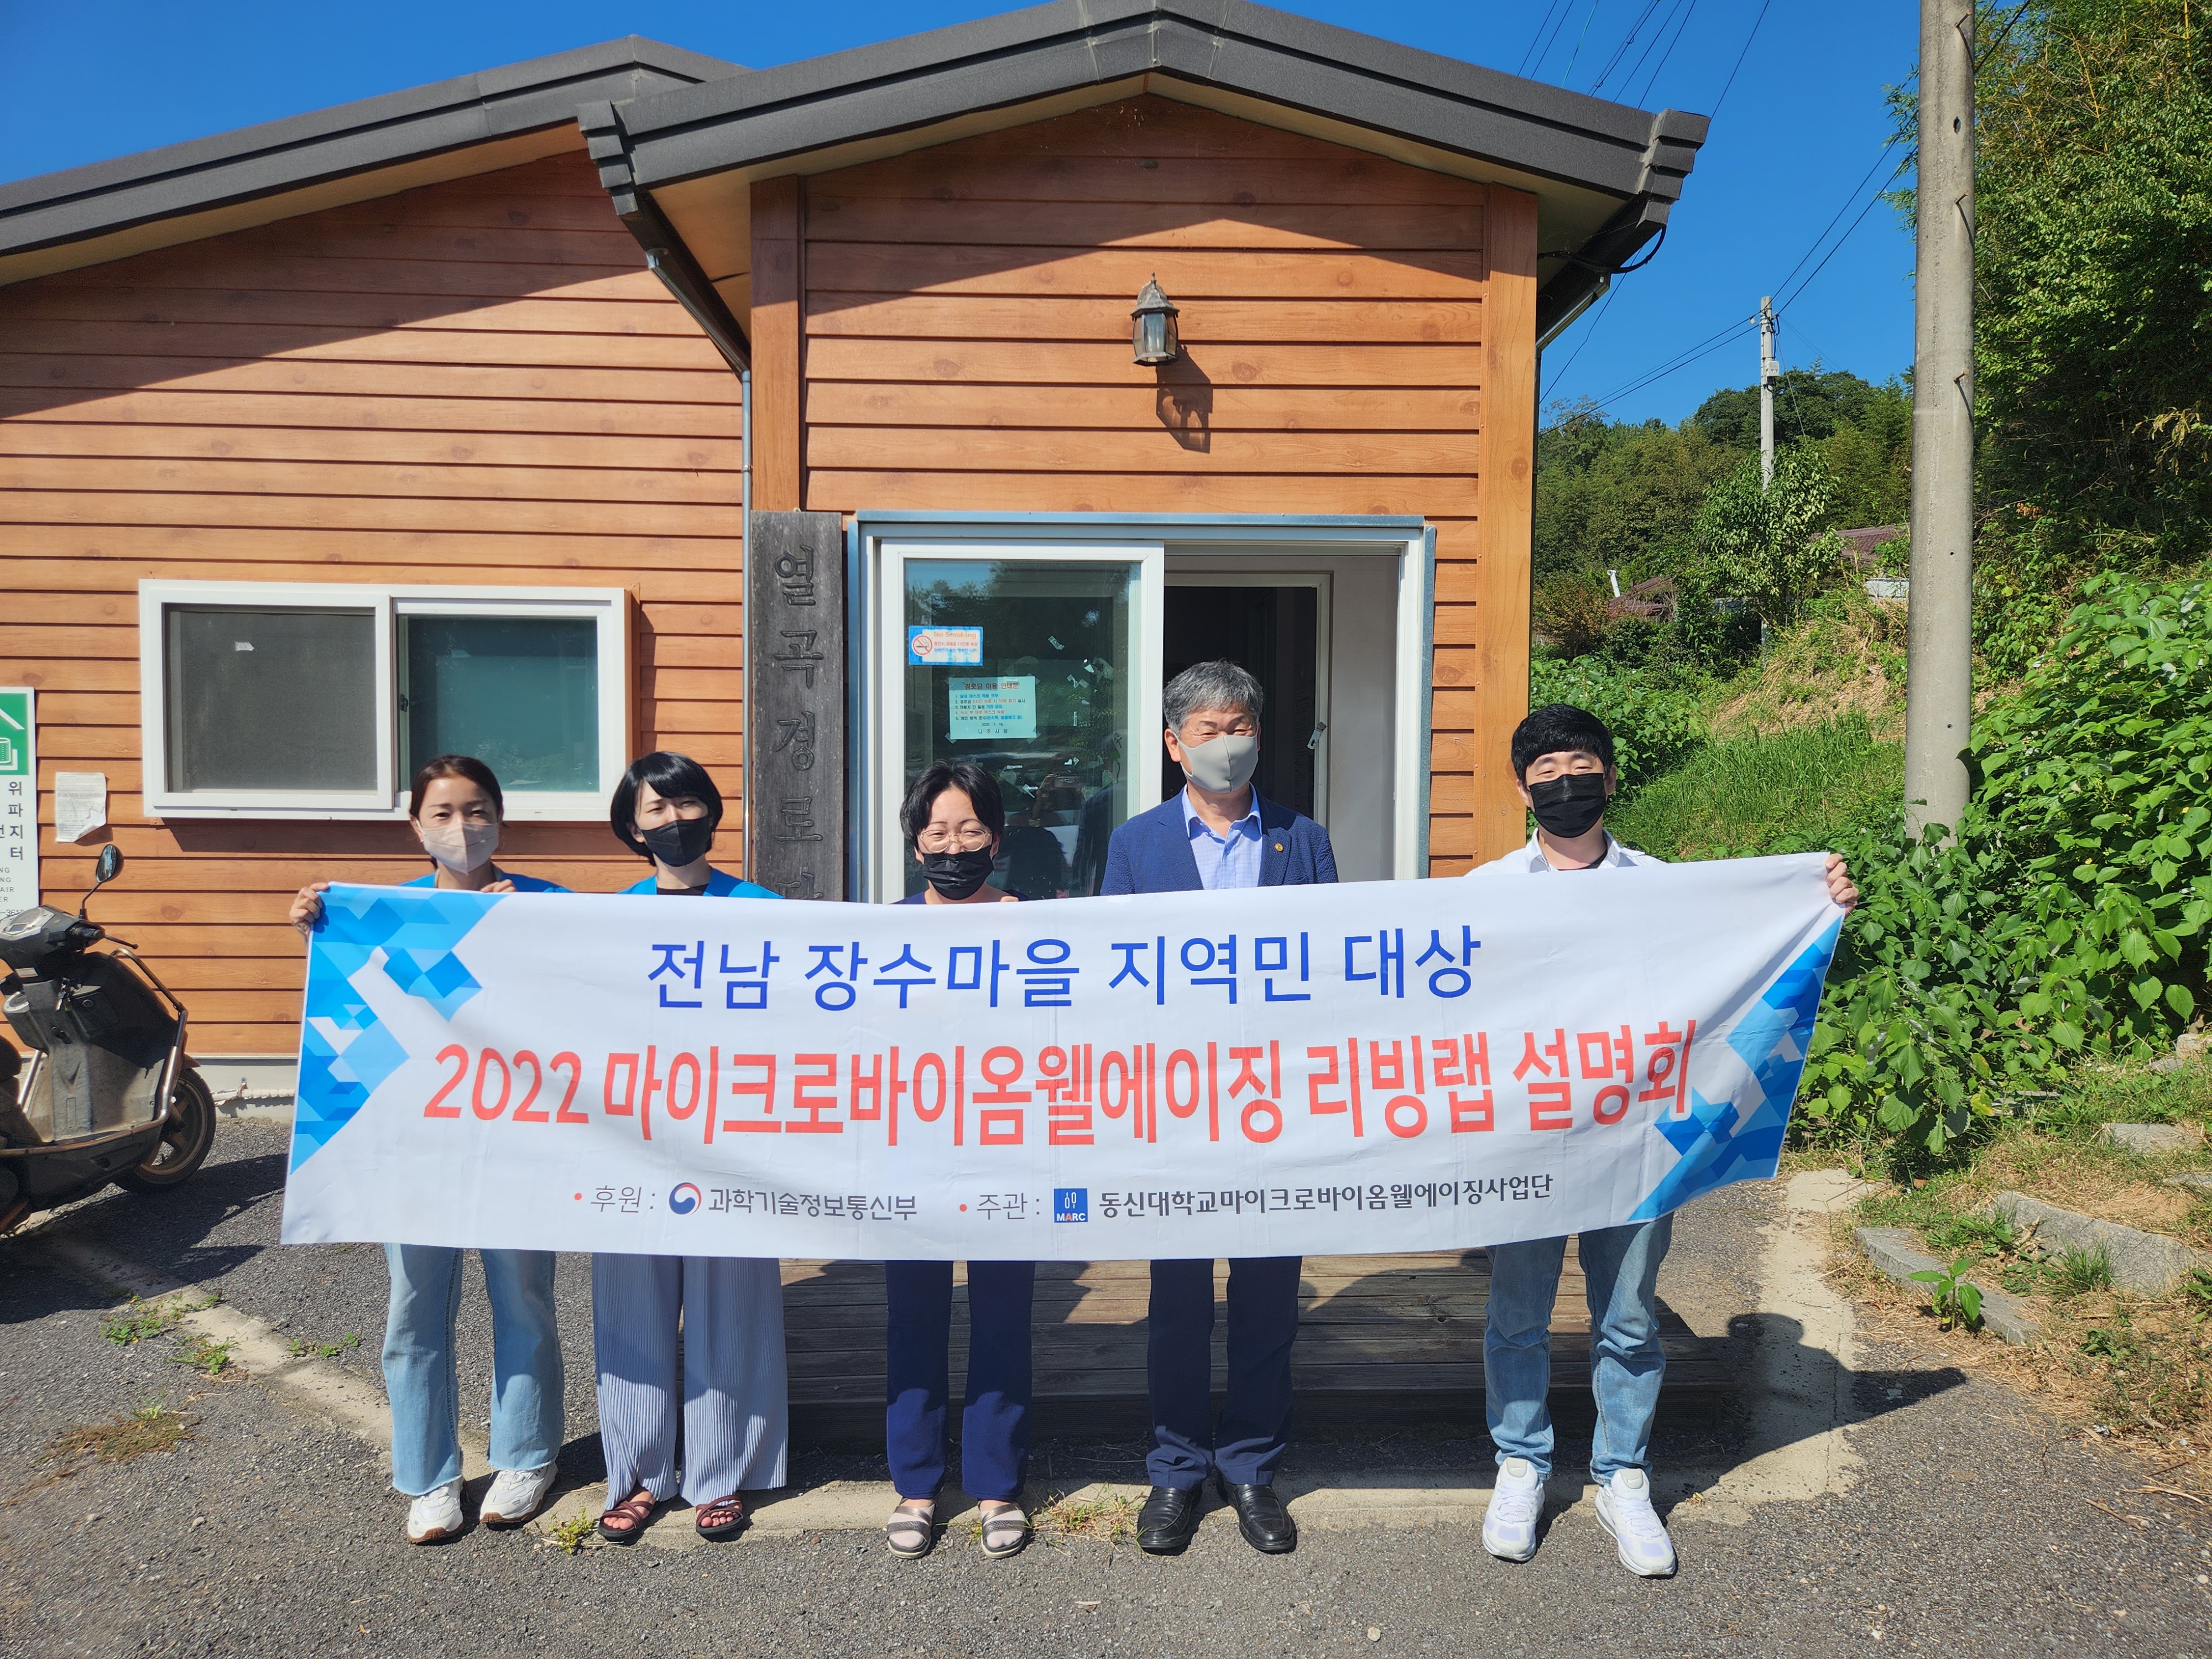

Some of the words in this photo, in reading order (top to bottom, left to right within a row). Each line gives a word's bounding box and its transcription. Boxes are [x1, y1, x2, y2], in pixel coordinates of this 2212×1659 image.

[648, 941, 780, 1009] 전남
[805, 938, 1080, 1011] 장수마을
[1109, 932, 1311, 1005] 지역민
[1344, 925, 1481, 998] 대상
[424, 1044, 589, 1124] 2022
[604, 1039, 1283, 1145] 마이크로바이옴웰에이징
[1307, 1032, 1494, 1138] 리빙랩
[1513, 1020, 1697, 1131] 설명회
[590, 1185, 642, 1213] 후원
[708, 1188, 917, 1220] 과학기술정보통신부
[977, 1192, 1028, 1220] 주관
[1099, 1173, 1553, 1218] 동신대학교마이크로바이옴웰에이징사업단
[1056, 1213, 1086, 1222] MARC
